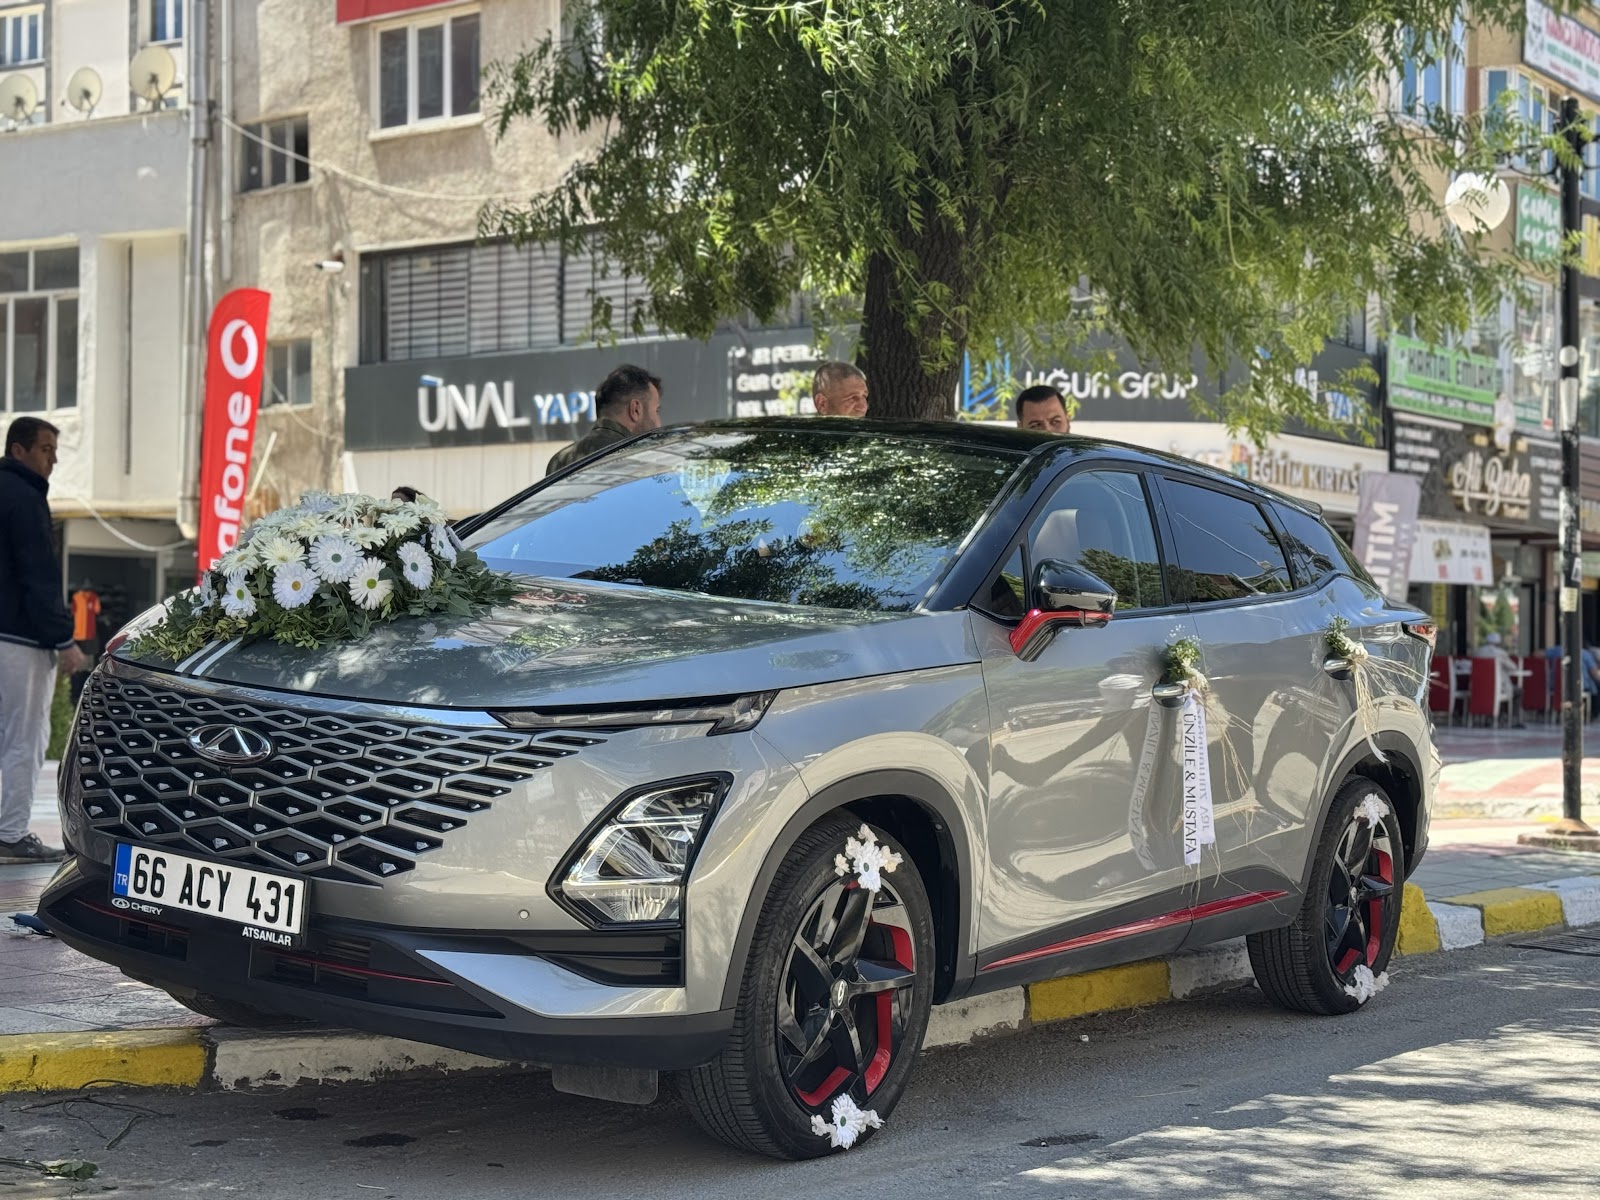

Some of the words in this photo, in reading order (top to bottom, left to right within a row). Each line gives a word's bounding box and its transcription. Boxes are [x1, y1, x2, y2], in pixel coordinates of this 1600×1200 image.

[417, 374, 531, 432] ÜNAL
[533, 390, 597, 425] YAPI
[210, 391, 252, 569] afone
[1308, 462, 1360, 494] KIRTAS
[1452, 451, 1483, 513] Ali
[1183, 713, 1197, 767] ÜNZİLE
[1184, 770, 1196, 781] &
[1184, 785, 1197, 855] MUSTAFA
[116, 872, 128, 887] TR
[133, 853, 167, 899] 66
[178, 863, 232, 913] ACY
[246, 876, 296, 928] 431
[131, 902, 163, 916] CHERY
[241, 926, 292, 947] ATSANLAR
